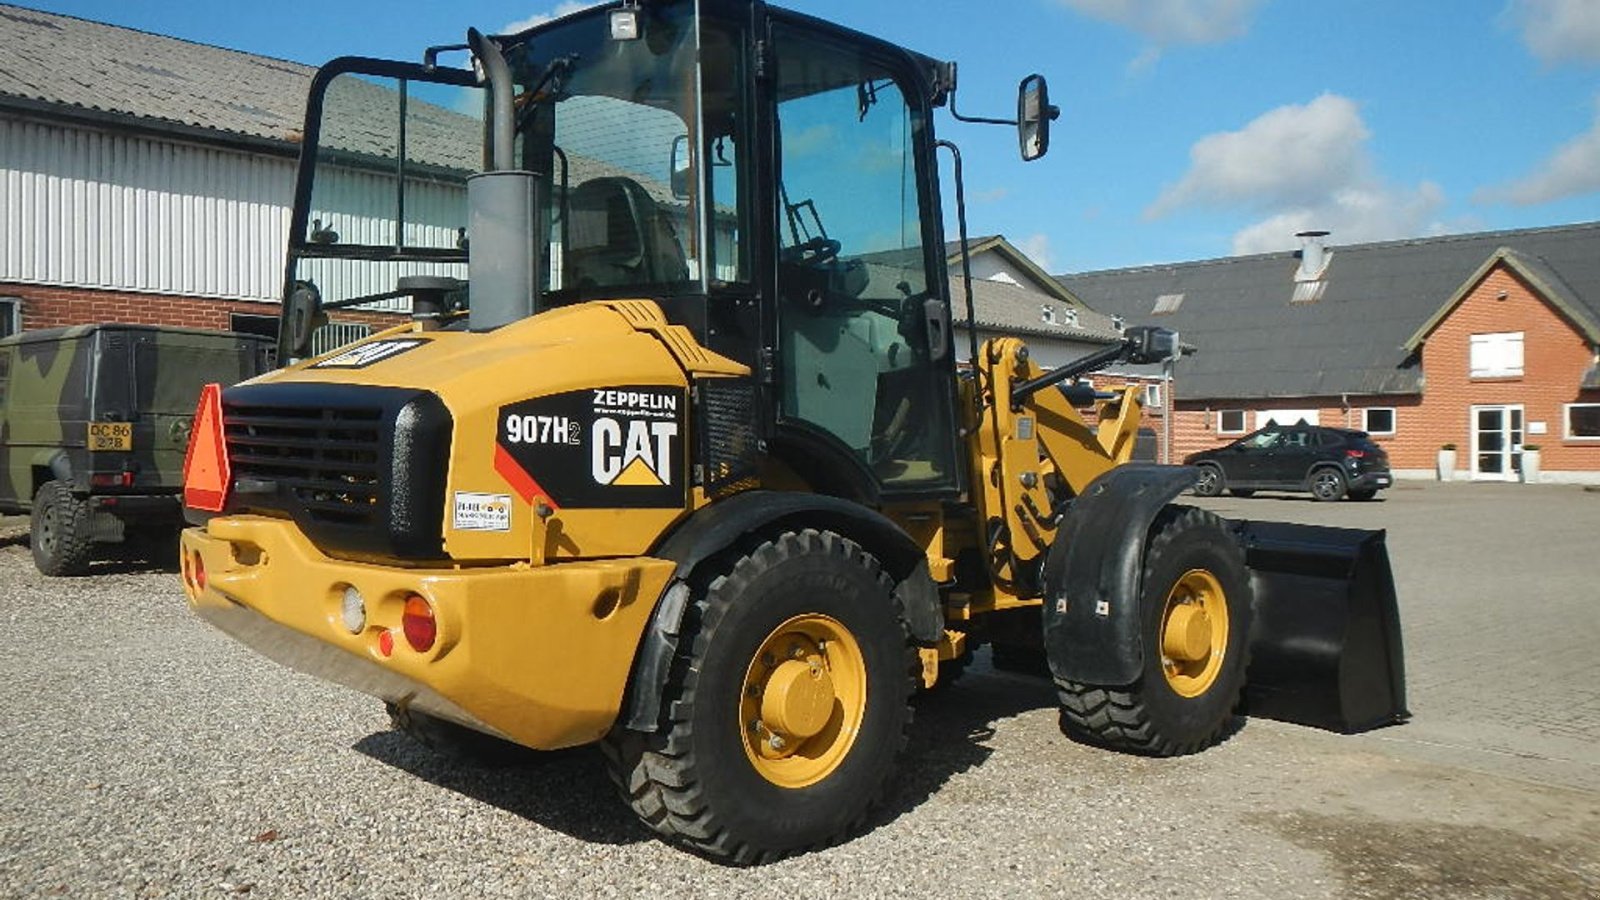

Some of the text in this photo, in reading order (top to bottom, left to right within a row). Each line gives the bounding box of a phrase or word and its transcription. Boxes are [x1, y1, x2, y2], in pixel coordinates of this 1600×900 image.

[593, 389, 676, 410] ZEPPELIN
[91, 424, 129, 437] DC 86
[592, 417, 678, 486] CAT
